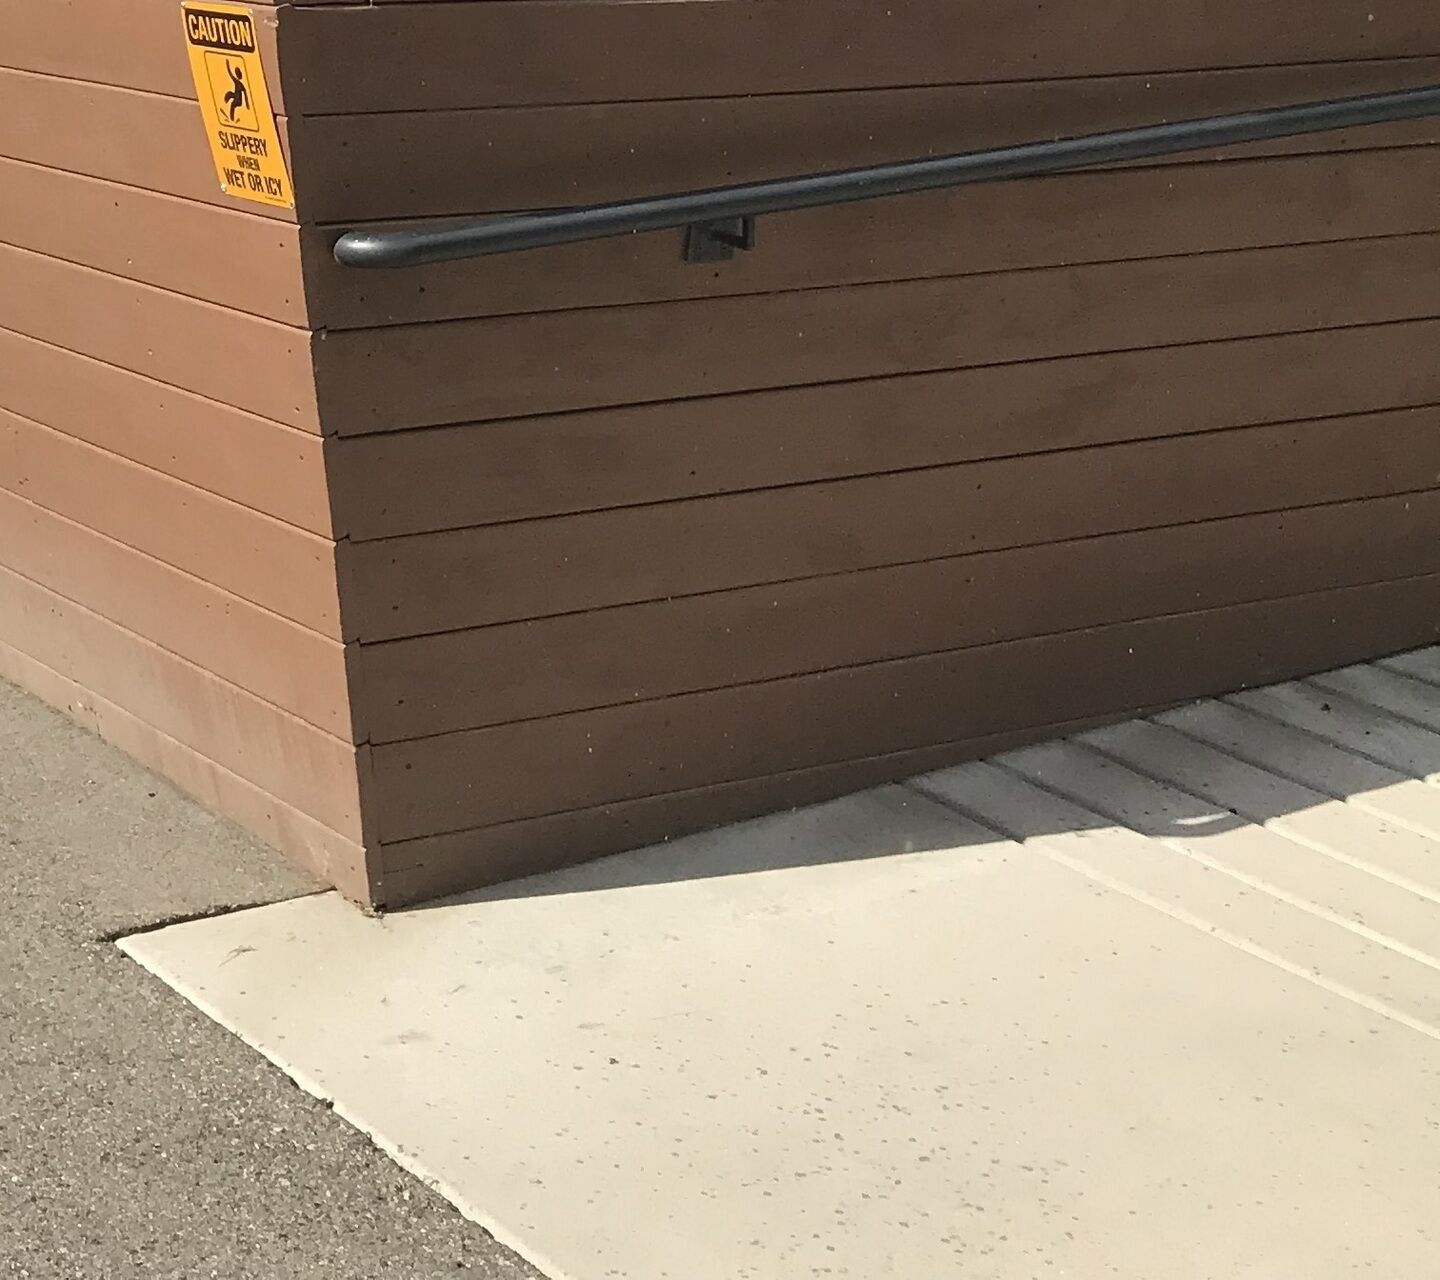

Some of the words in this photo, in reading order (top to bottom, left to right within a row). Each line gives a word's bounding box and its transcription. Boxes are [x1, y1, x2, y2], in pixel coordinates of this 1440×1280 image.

[188, 14, 253, 47] CAUTION
[218, 131, 267, 157] SLIPPERY
[236, 154, 260, 171] WHEN
[223, 167, 246, 189] WET
[247, 172, 264, 193] OR
[264, 176, 283, 197] ICY
